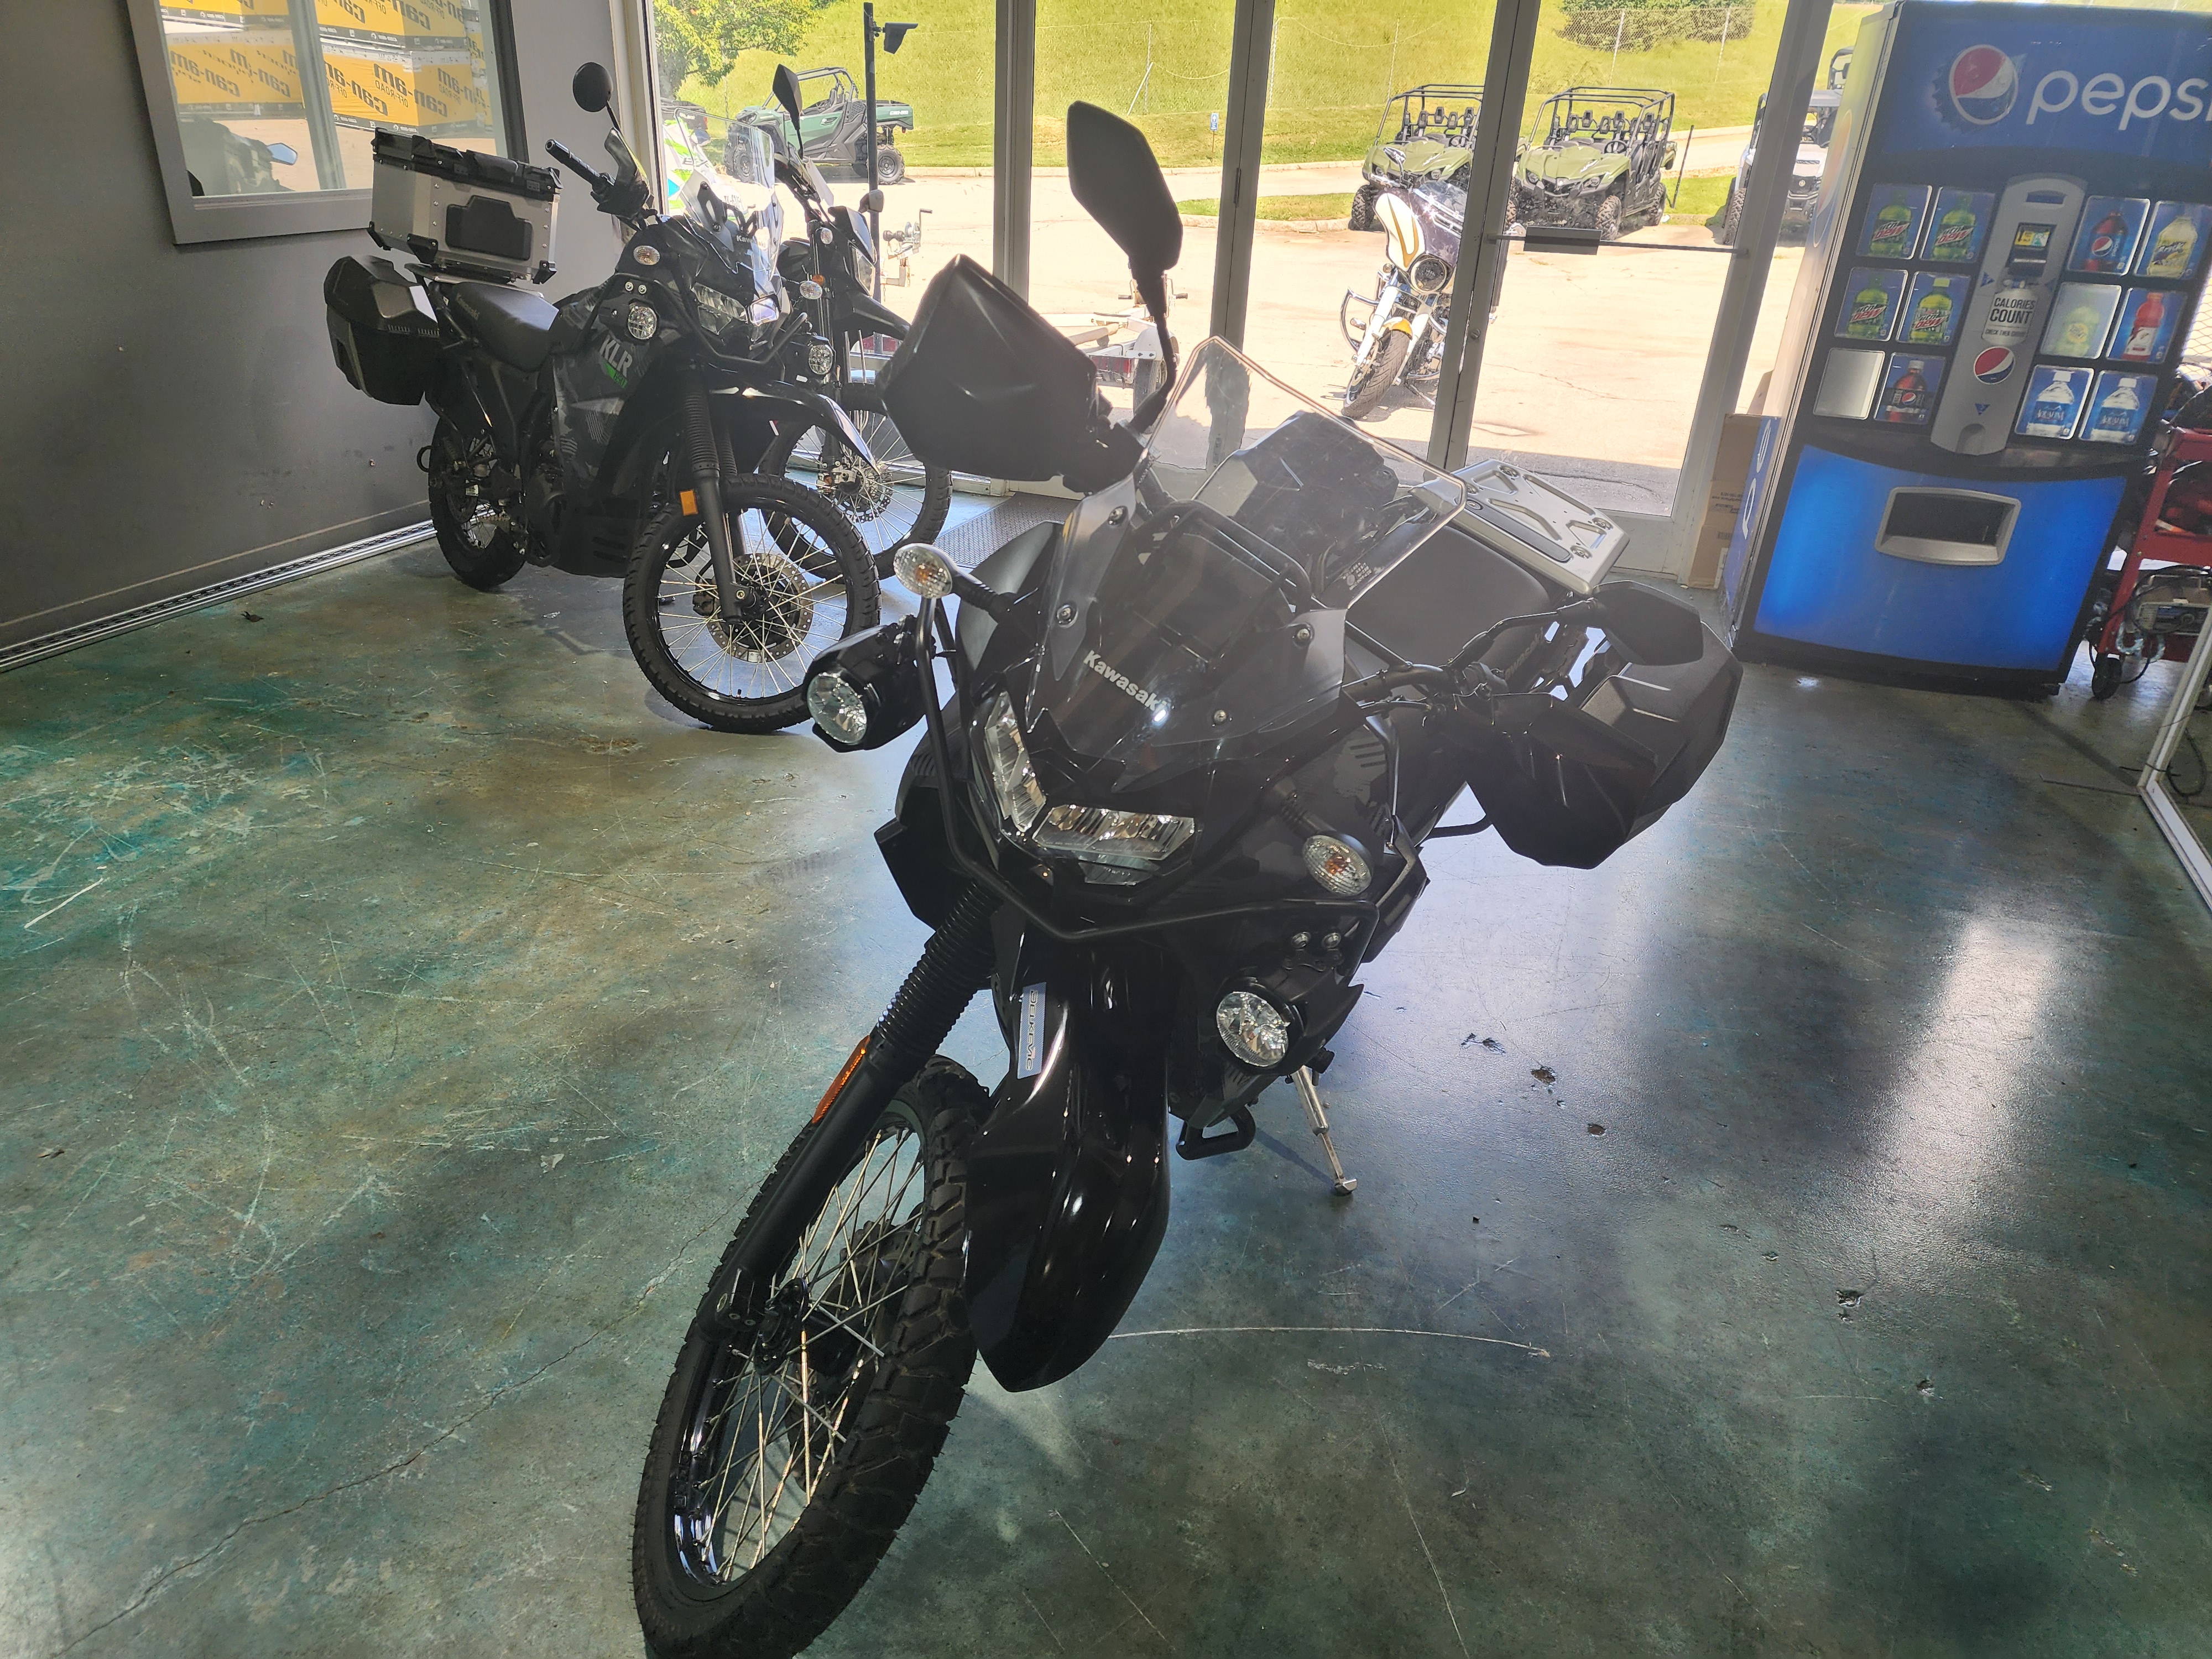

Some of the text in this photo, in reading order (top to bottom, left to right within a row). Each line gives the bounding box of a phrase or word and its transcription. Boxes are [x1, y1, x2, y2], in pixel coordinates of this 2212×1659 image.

[1990, 308, 2032, 324] COUNT
[1994, 297, 2037, 310] CALORIES
[599, 333, 633, 378] KLR
[1083, 650, 1167, 717] Kawasaki
